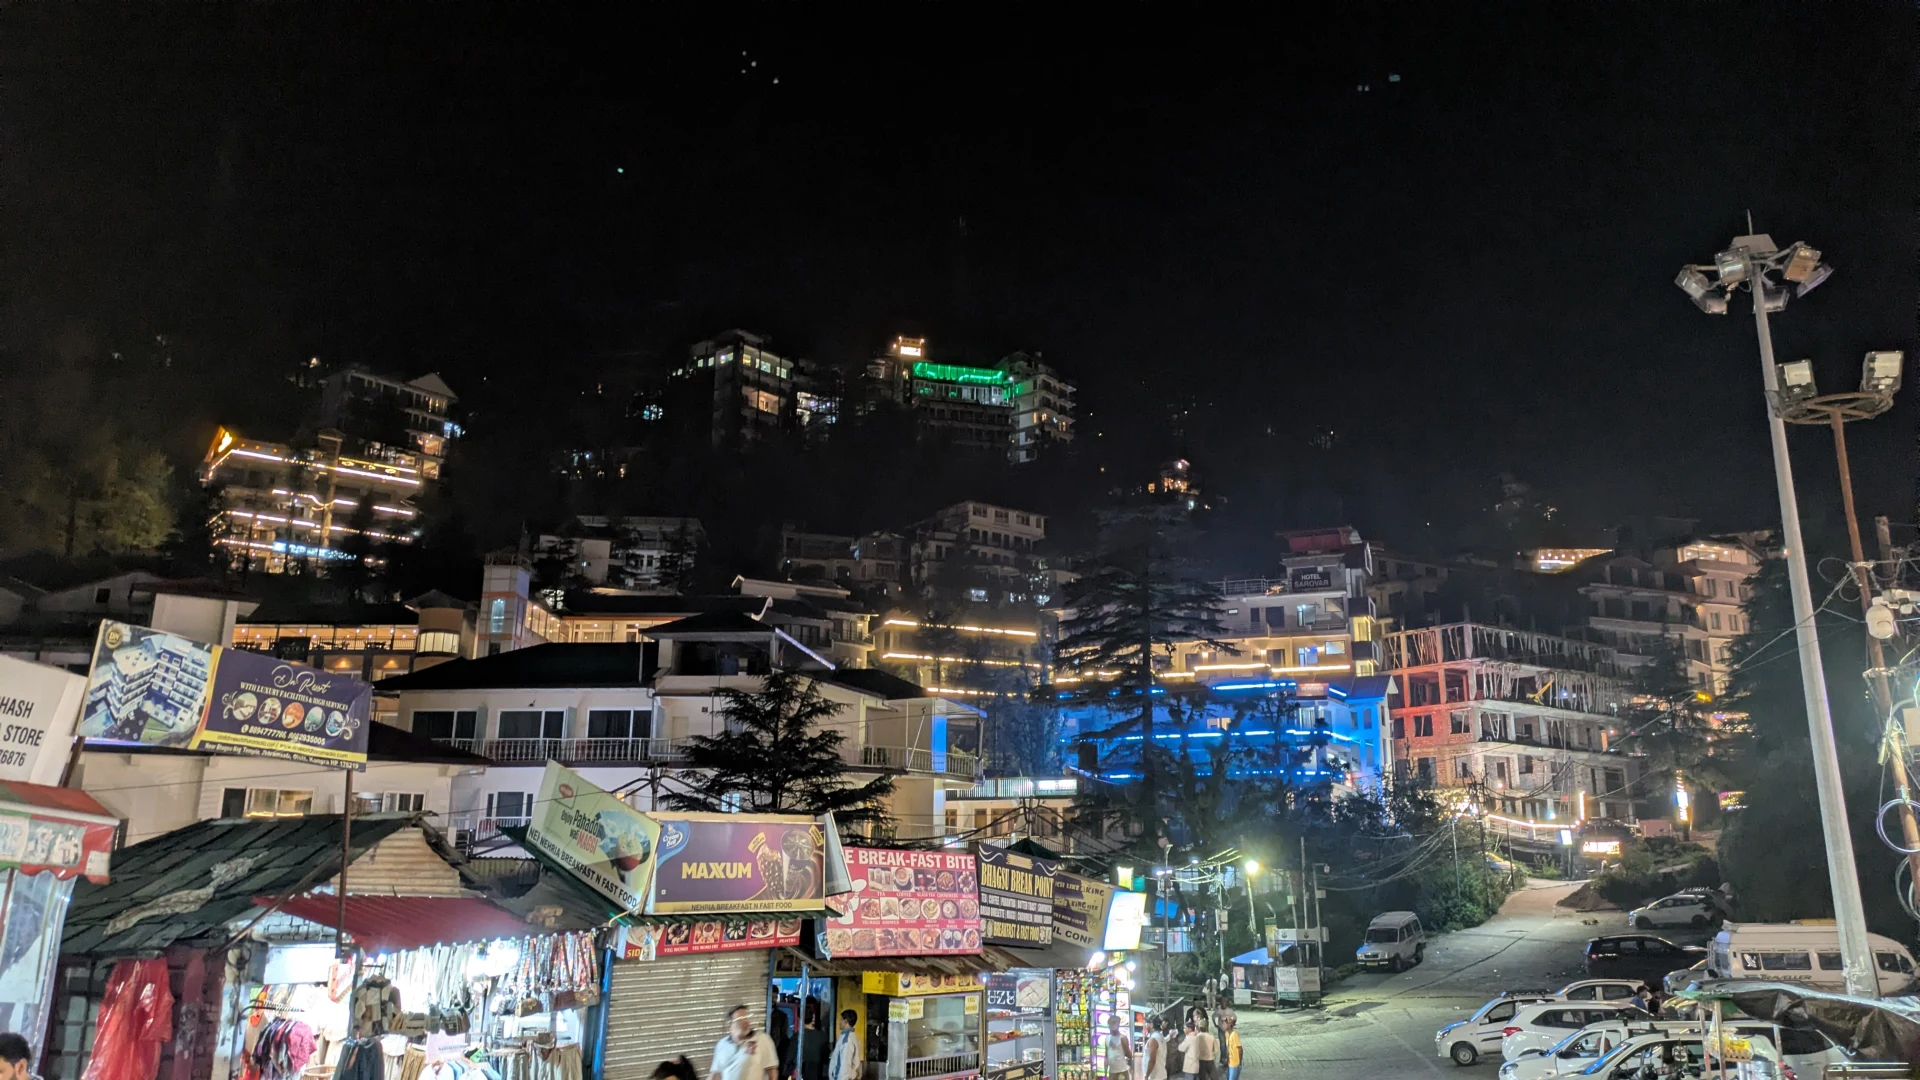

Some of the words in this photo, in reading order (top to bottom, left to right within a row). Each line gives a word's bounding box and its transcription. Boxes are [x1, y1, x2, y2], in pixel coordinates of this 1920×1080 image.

[1294, 580, 1328, 588] SAROVAR
[240, 682, 256, 691] WITH
[256, 684, 279, 696] LUXURY
[280, 690, 308, 702] FACILITIES
[4, 724, 44, 746] STORE
[309, 757, 330, 765] Kangra
[859, 851, 942, 868] BREAK-FAST
[947, 856, 975, 870] BITE
[540, 837, 560, 858] NEHRIA
[561, 850, 596, 880] BREAKFAST
[595, 872, 602, 883] N
[601, 877, 618, 894] FAST
[619, 890, 637, 907] FOOD
[981, 863, 1009, 891] BHAGSU
[1010, 869, 1032, 895] BREAK
[1034, 874, 1054, 898] POINT
[1066, 883, 1080, 891] LIKE
[1086, 887, 1104, 896] KING
[1071, 900, 1086, 909] KING
[994, 921, 1016, 938] BREAKFAST
[1017, 924, 1020, 939] &
[1021, 924, 1030, 940] FAST
[1030, 926, 1039, 941] FOOD
